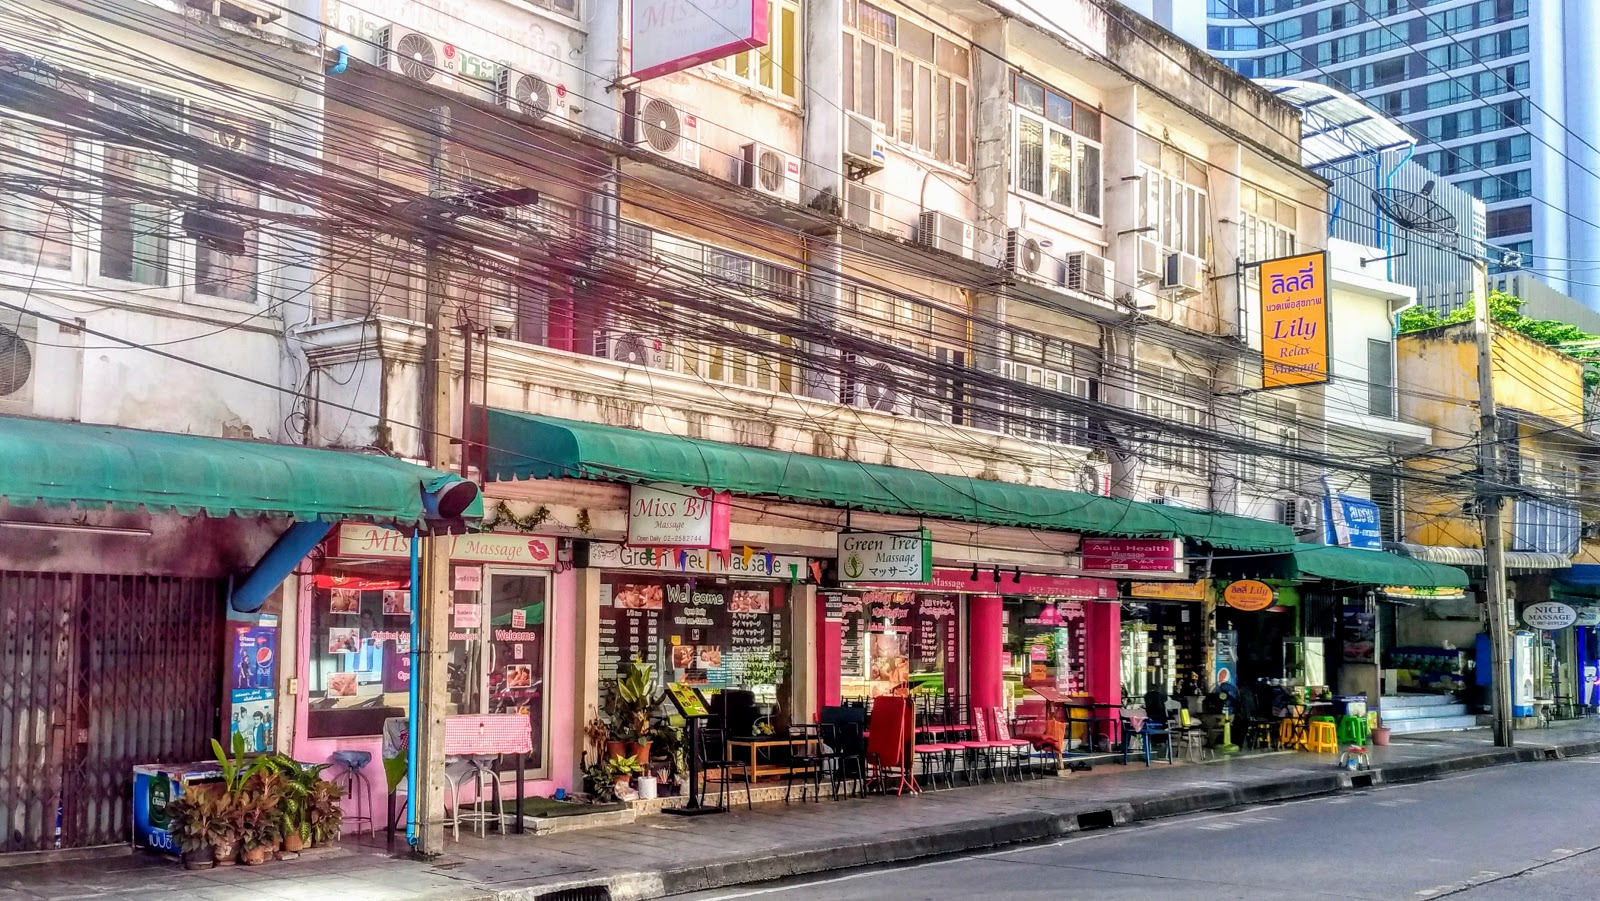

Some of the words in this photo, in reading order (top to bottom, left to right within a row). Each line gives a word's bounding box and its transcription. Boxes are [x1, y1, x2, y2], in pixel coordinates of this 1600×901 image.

[444, 60, 454, 69] LG
[556, 99, 565, 108] LG
[685, 117, 696, 125] TCL
[1270, 261, 1313, 294] ลิลลี่
[1271, 316, 1317, 340] Lily
[1280, 344, 1311, 358] Relax
[653, 355, 661, 363] LG
[633, 498, 676, 518] Miss
[654, 521, 684, 531] Massage
[844, 537, 883, 551] Green
[890, 536, 918, 551] Tree
[465, 541, 523, 560] Massage
[875, 553, 916, 567] Massage
[869, 563, 919, 577] マッサージ
[932, 578, 965, 590] Massage
[1249, 586, 1268, 596] Lily
[495, 629, 536, 641] Welcome
